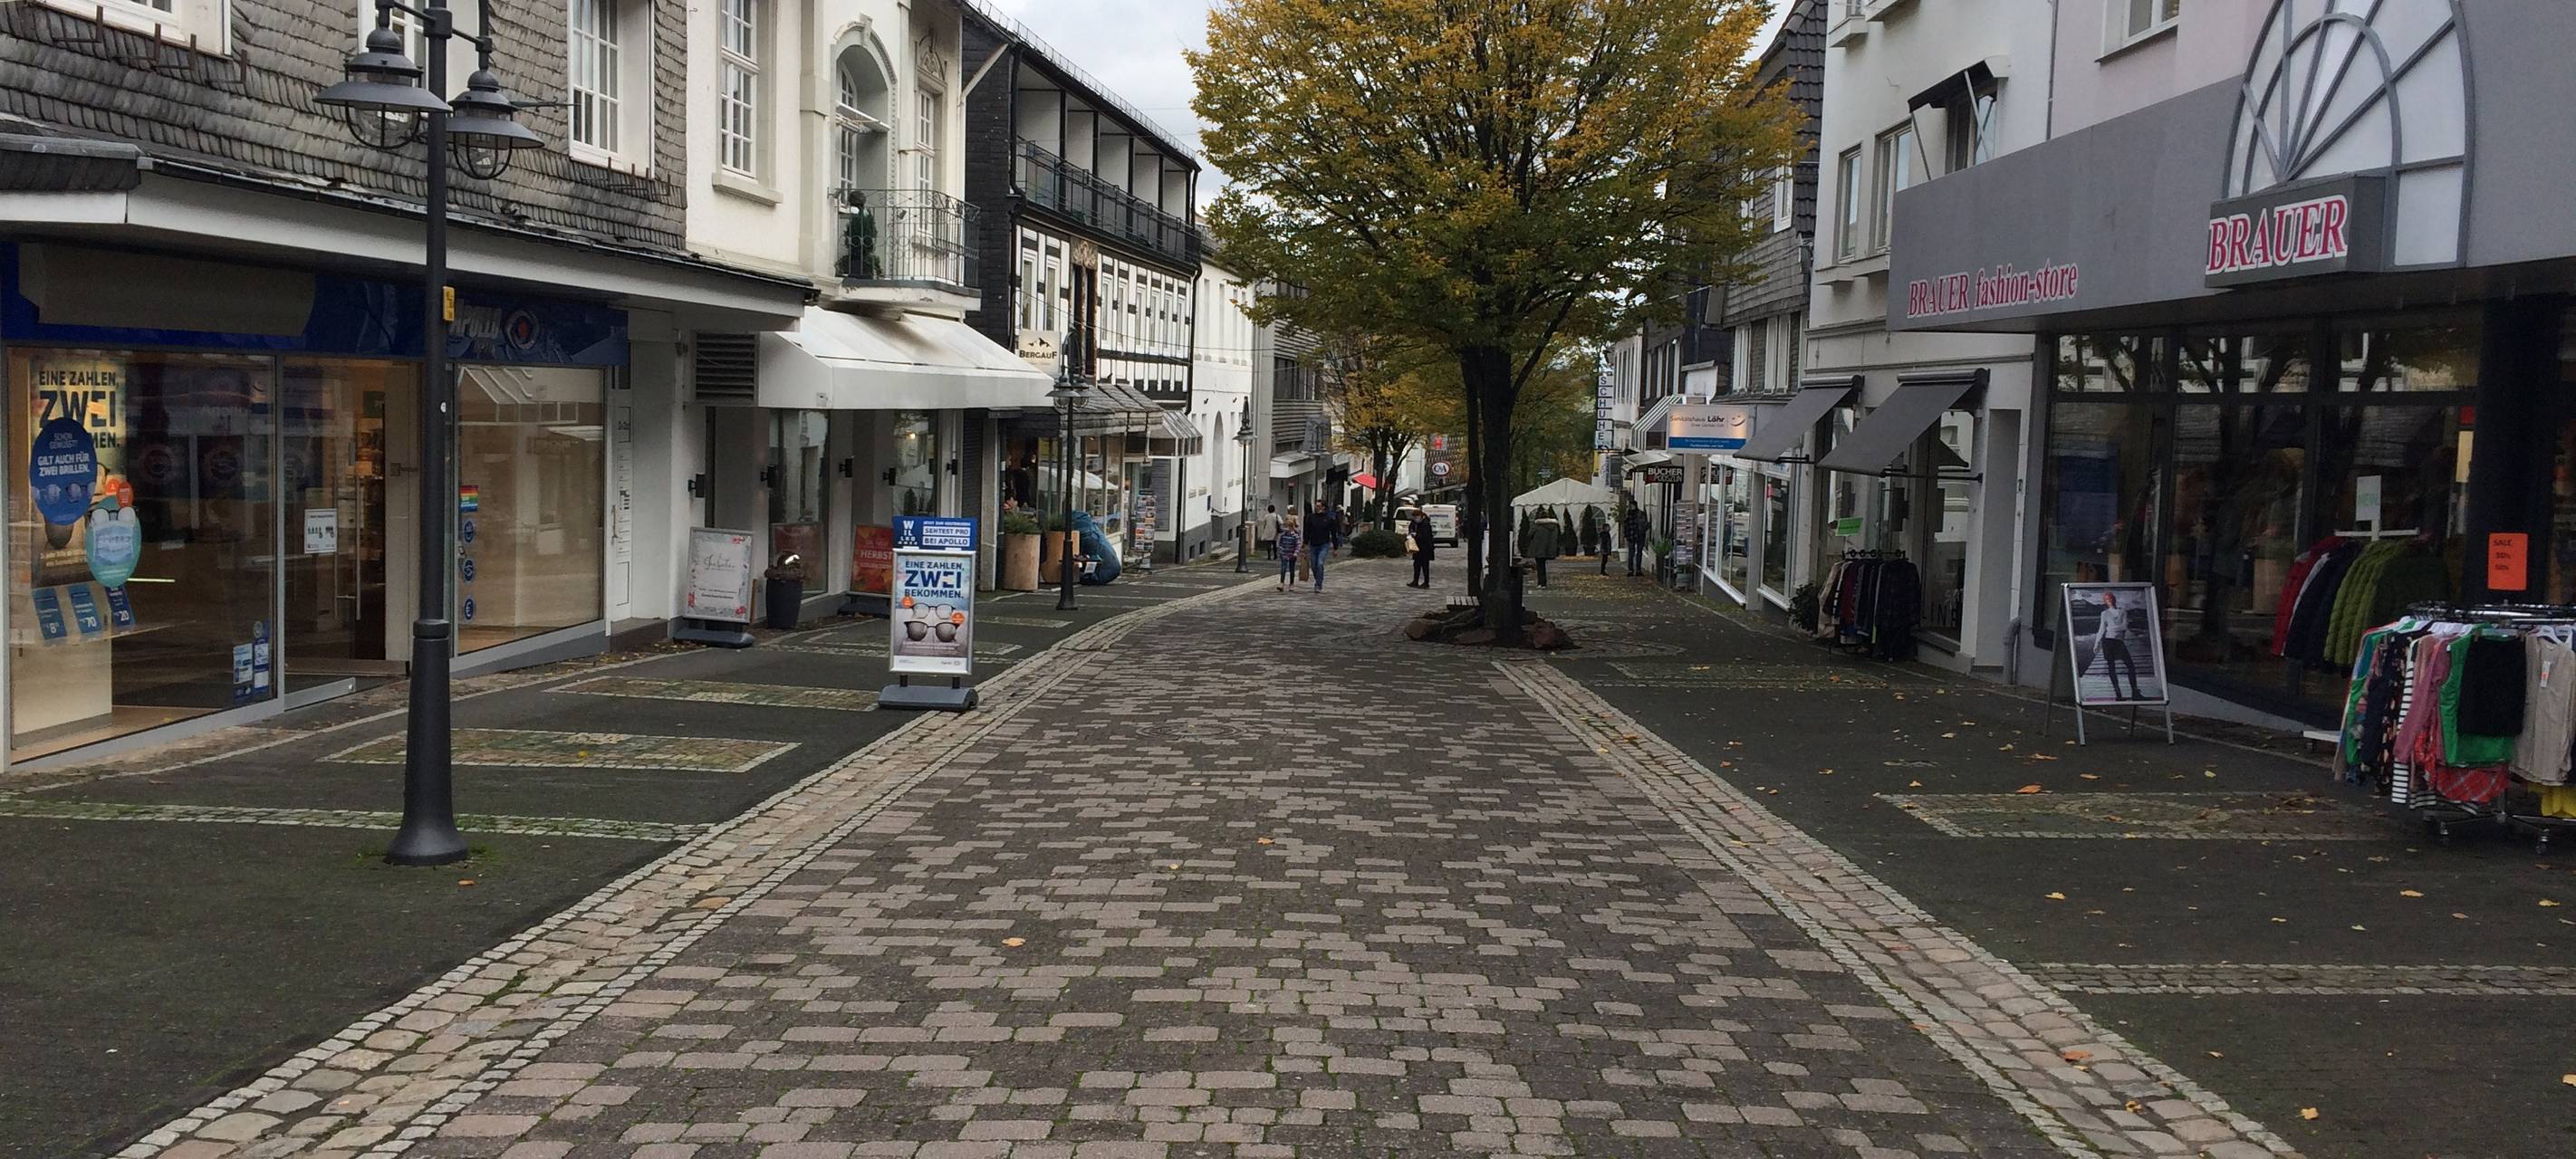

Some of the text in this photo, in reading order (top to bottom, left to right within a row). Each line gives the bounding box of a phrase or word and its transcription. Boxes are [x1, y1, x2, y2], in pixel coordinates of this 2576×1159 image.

[2206, 196, 2347, 273] BRAUER
[1908, 260, 2078, 317] BRAUER fashion-store
[1019, 350, 1057, 359] BERGAUF
[39, 370, 120, 388] EINE ZAHLEN,
[39, 390, 116, 428] ZWEI
[1598, 377, 1607, 440] SCHUHE
[1707, 415, 1725, 423] Löhr
[38, 451, 91, 465] GILT AUCH FÜR
[39, 465, 58, 476] ZWEI
[1648, 465, 1683, 475] BÜCHER
[903, 521, 915, 529] W
[860, 550, 893, 560] HERBST
[927, 561, 965, 570] ZAHLEN,
[904, 570, 962, 589] ZWEI
[904, 589, 964, 599] BEKOMMEN.
